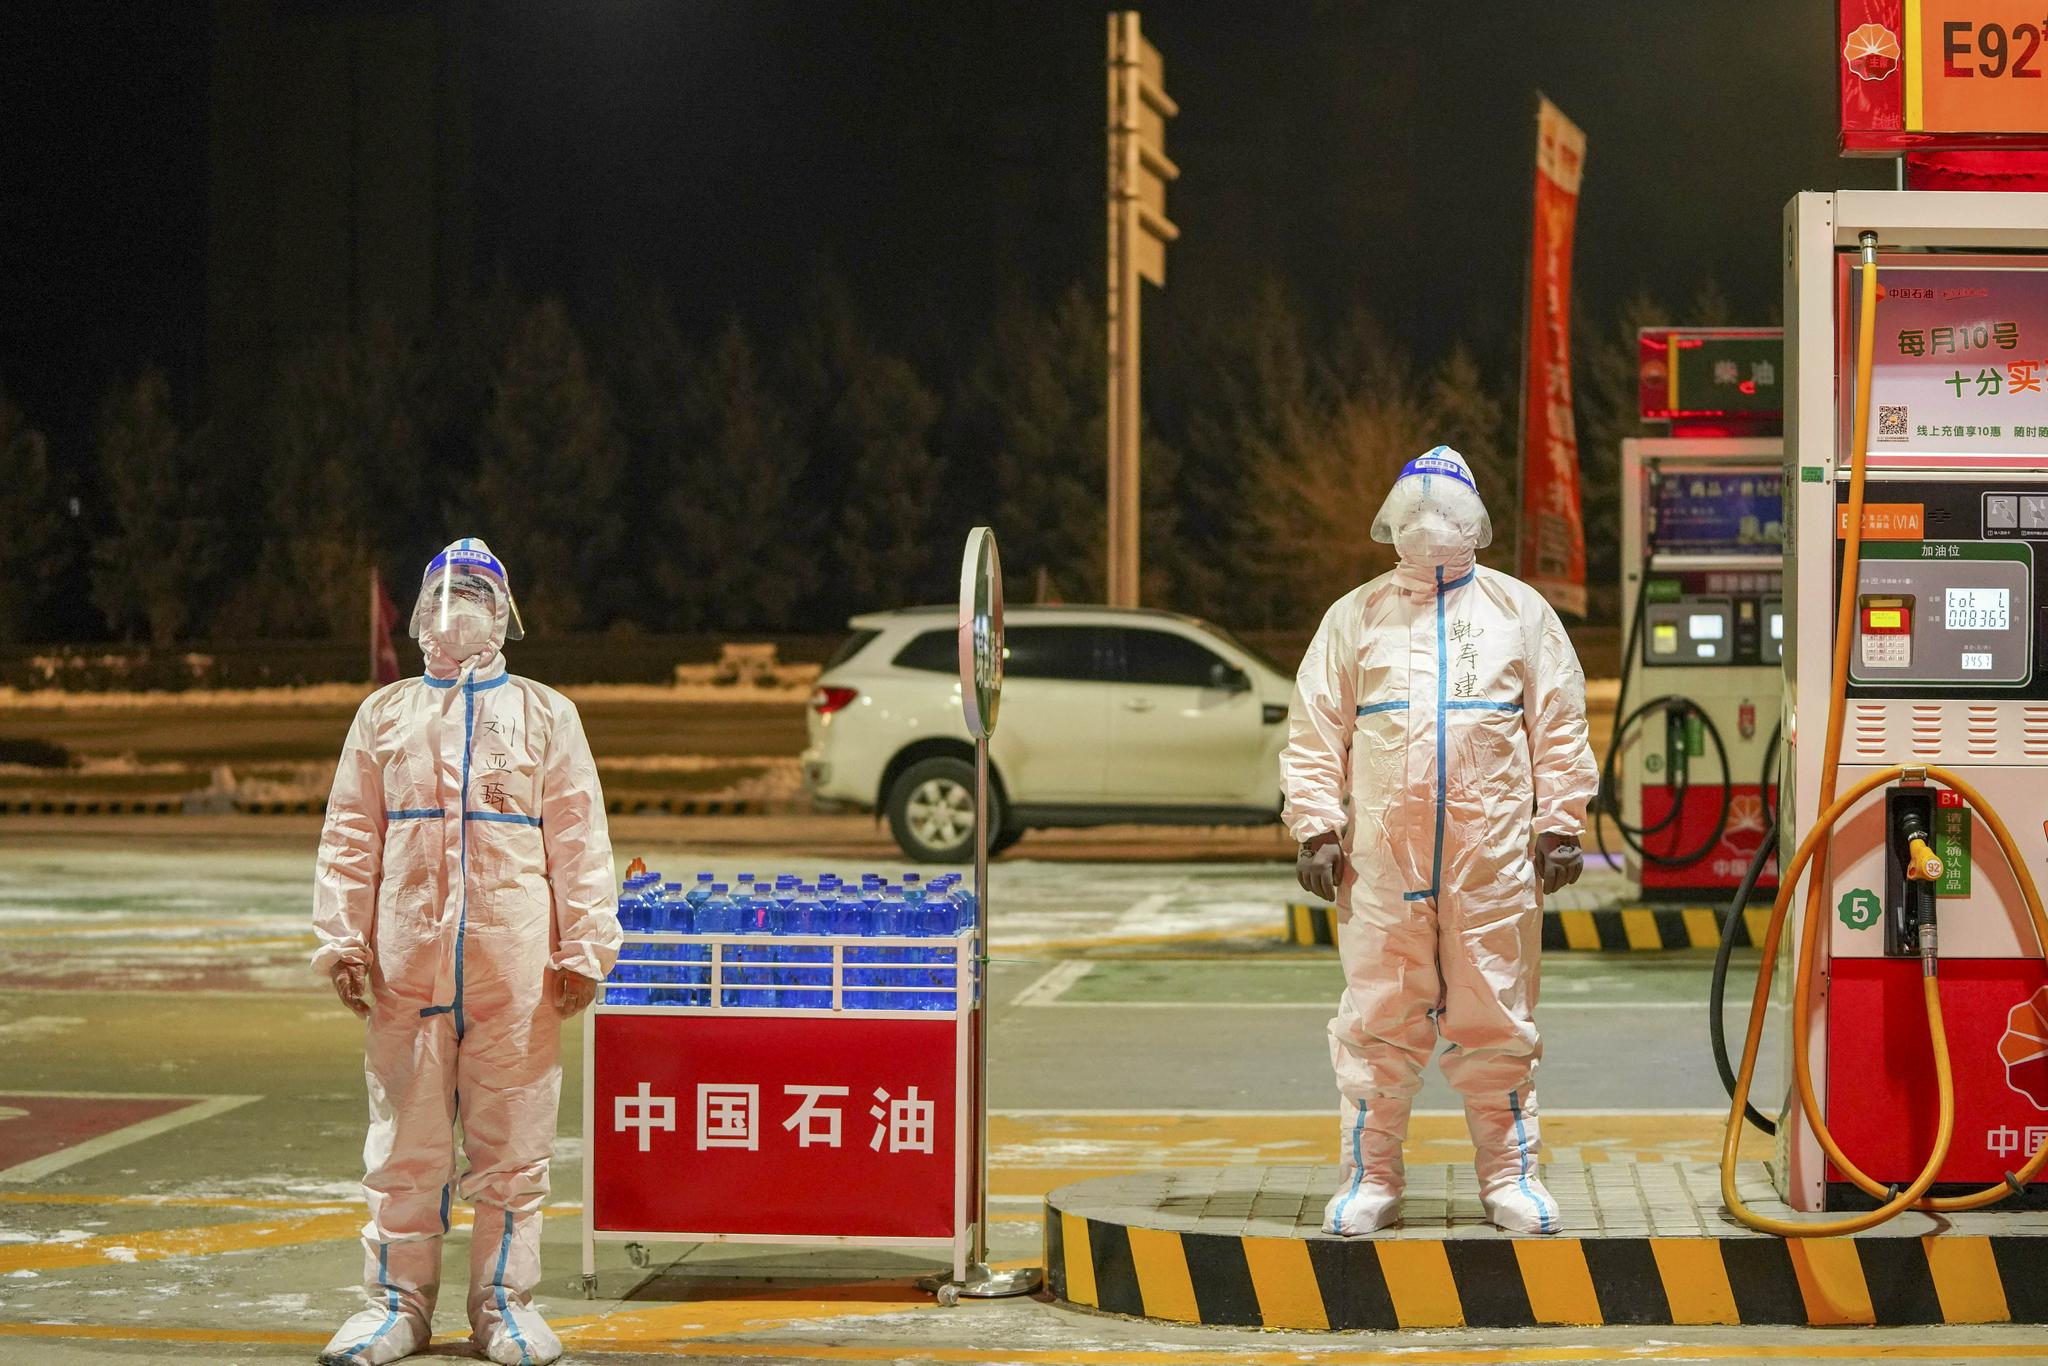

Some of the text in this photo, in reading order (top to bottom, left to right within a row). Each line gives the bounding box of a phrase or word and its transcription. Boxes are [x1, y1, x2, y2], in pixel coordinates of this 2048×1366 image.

[1889, 288, 1934, 299] 中国石油
[1898, 322, 2019, 357] 每月10号
[1944, 360, 2048, 398] 十分实
[1916, 425, 2002, 438] 线上充值享10惠
[1921, 544, 1961, 557] 加油位
[1948, 609, 2007, 627] 008365
[1941, 793, 1961, 805] B1
[1945, 811, 1962, 890] 请再次确认油品
[1928, 862, 1940, 873] 92
[1851, 897, 1869, 923] 5
[614, 1081, 935, 1154] 中国石油
